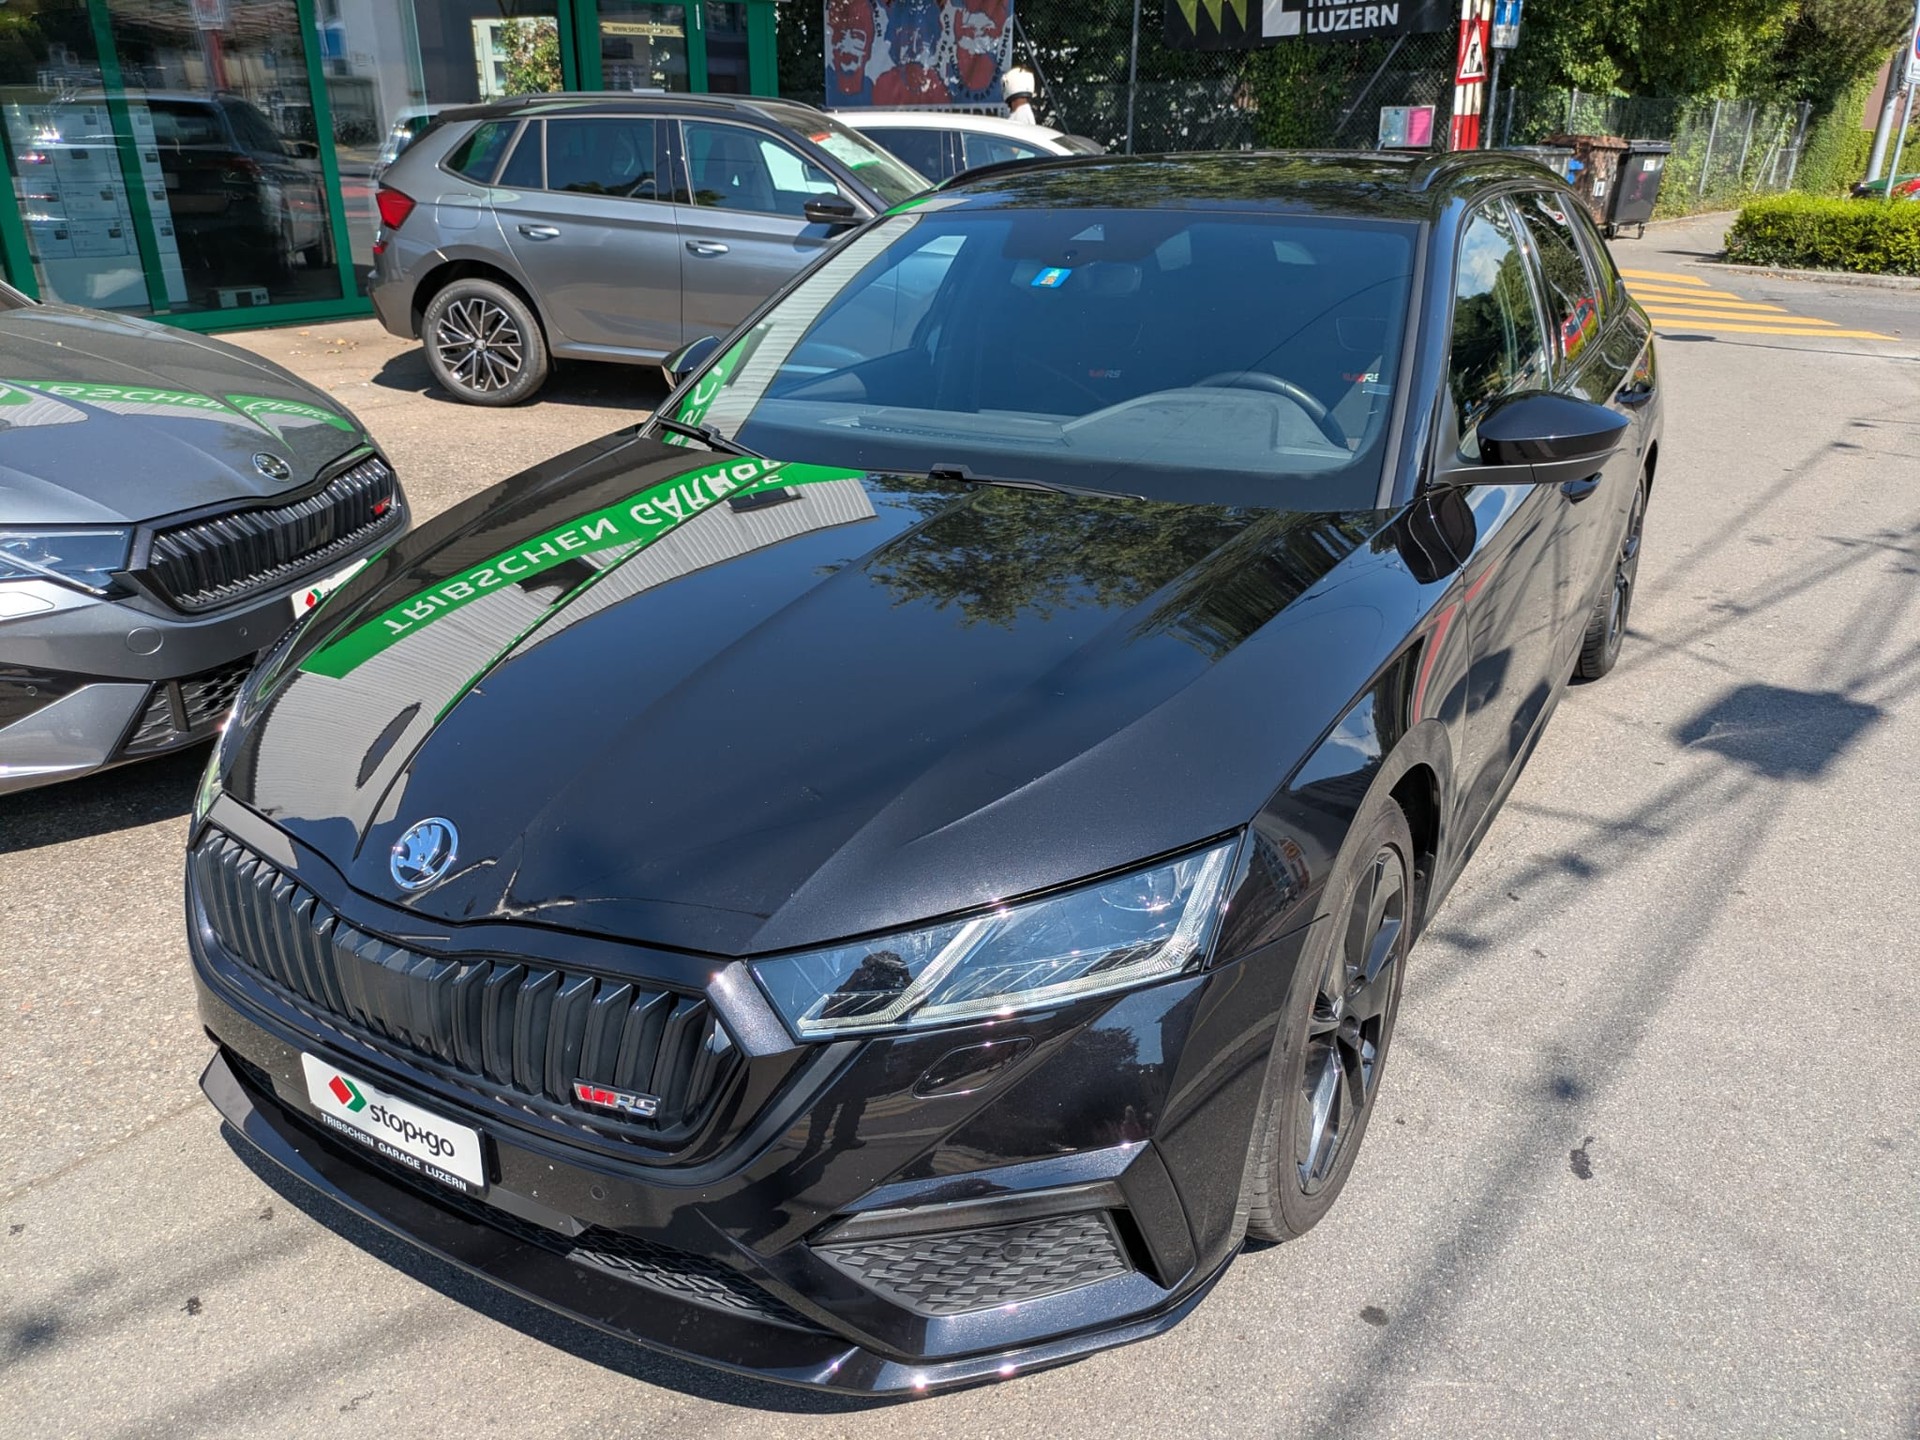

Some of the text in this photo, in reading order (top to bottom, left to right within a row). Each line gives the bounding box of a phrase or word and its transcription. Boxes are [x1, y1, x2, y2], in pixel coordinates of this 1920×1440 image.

[1306, 3, 1399, 33] LUZERN
[320, 1112, 468, 1193] TRIBSCHEN GARAGE LUZERN
[369, 1100, 455, 1158] stop+go
